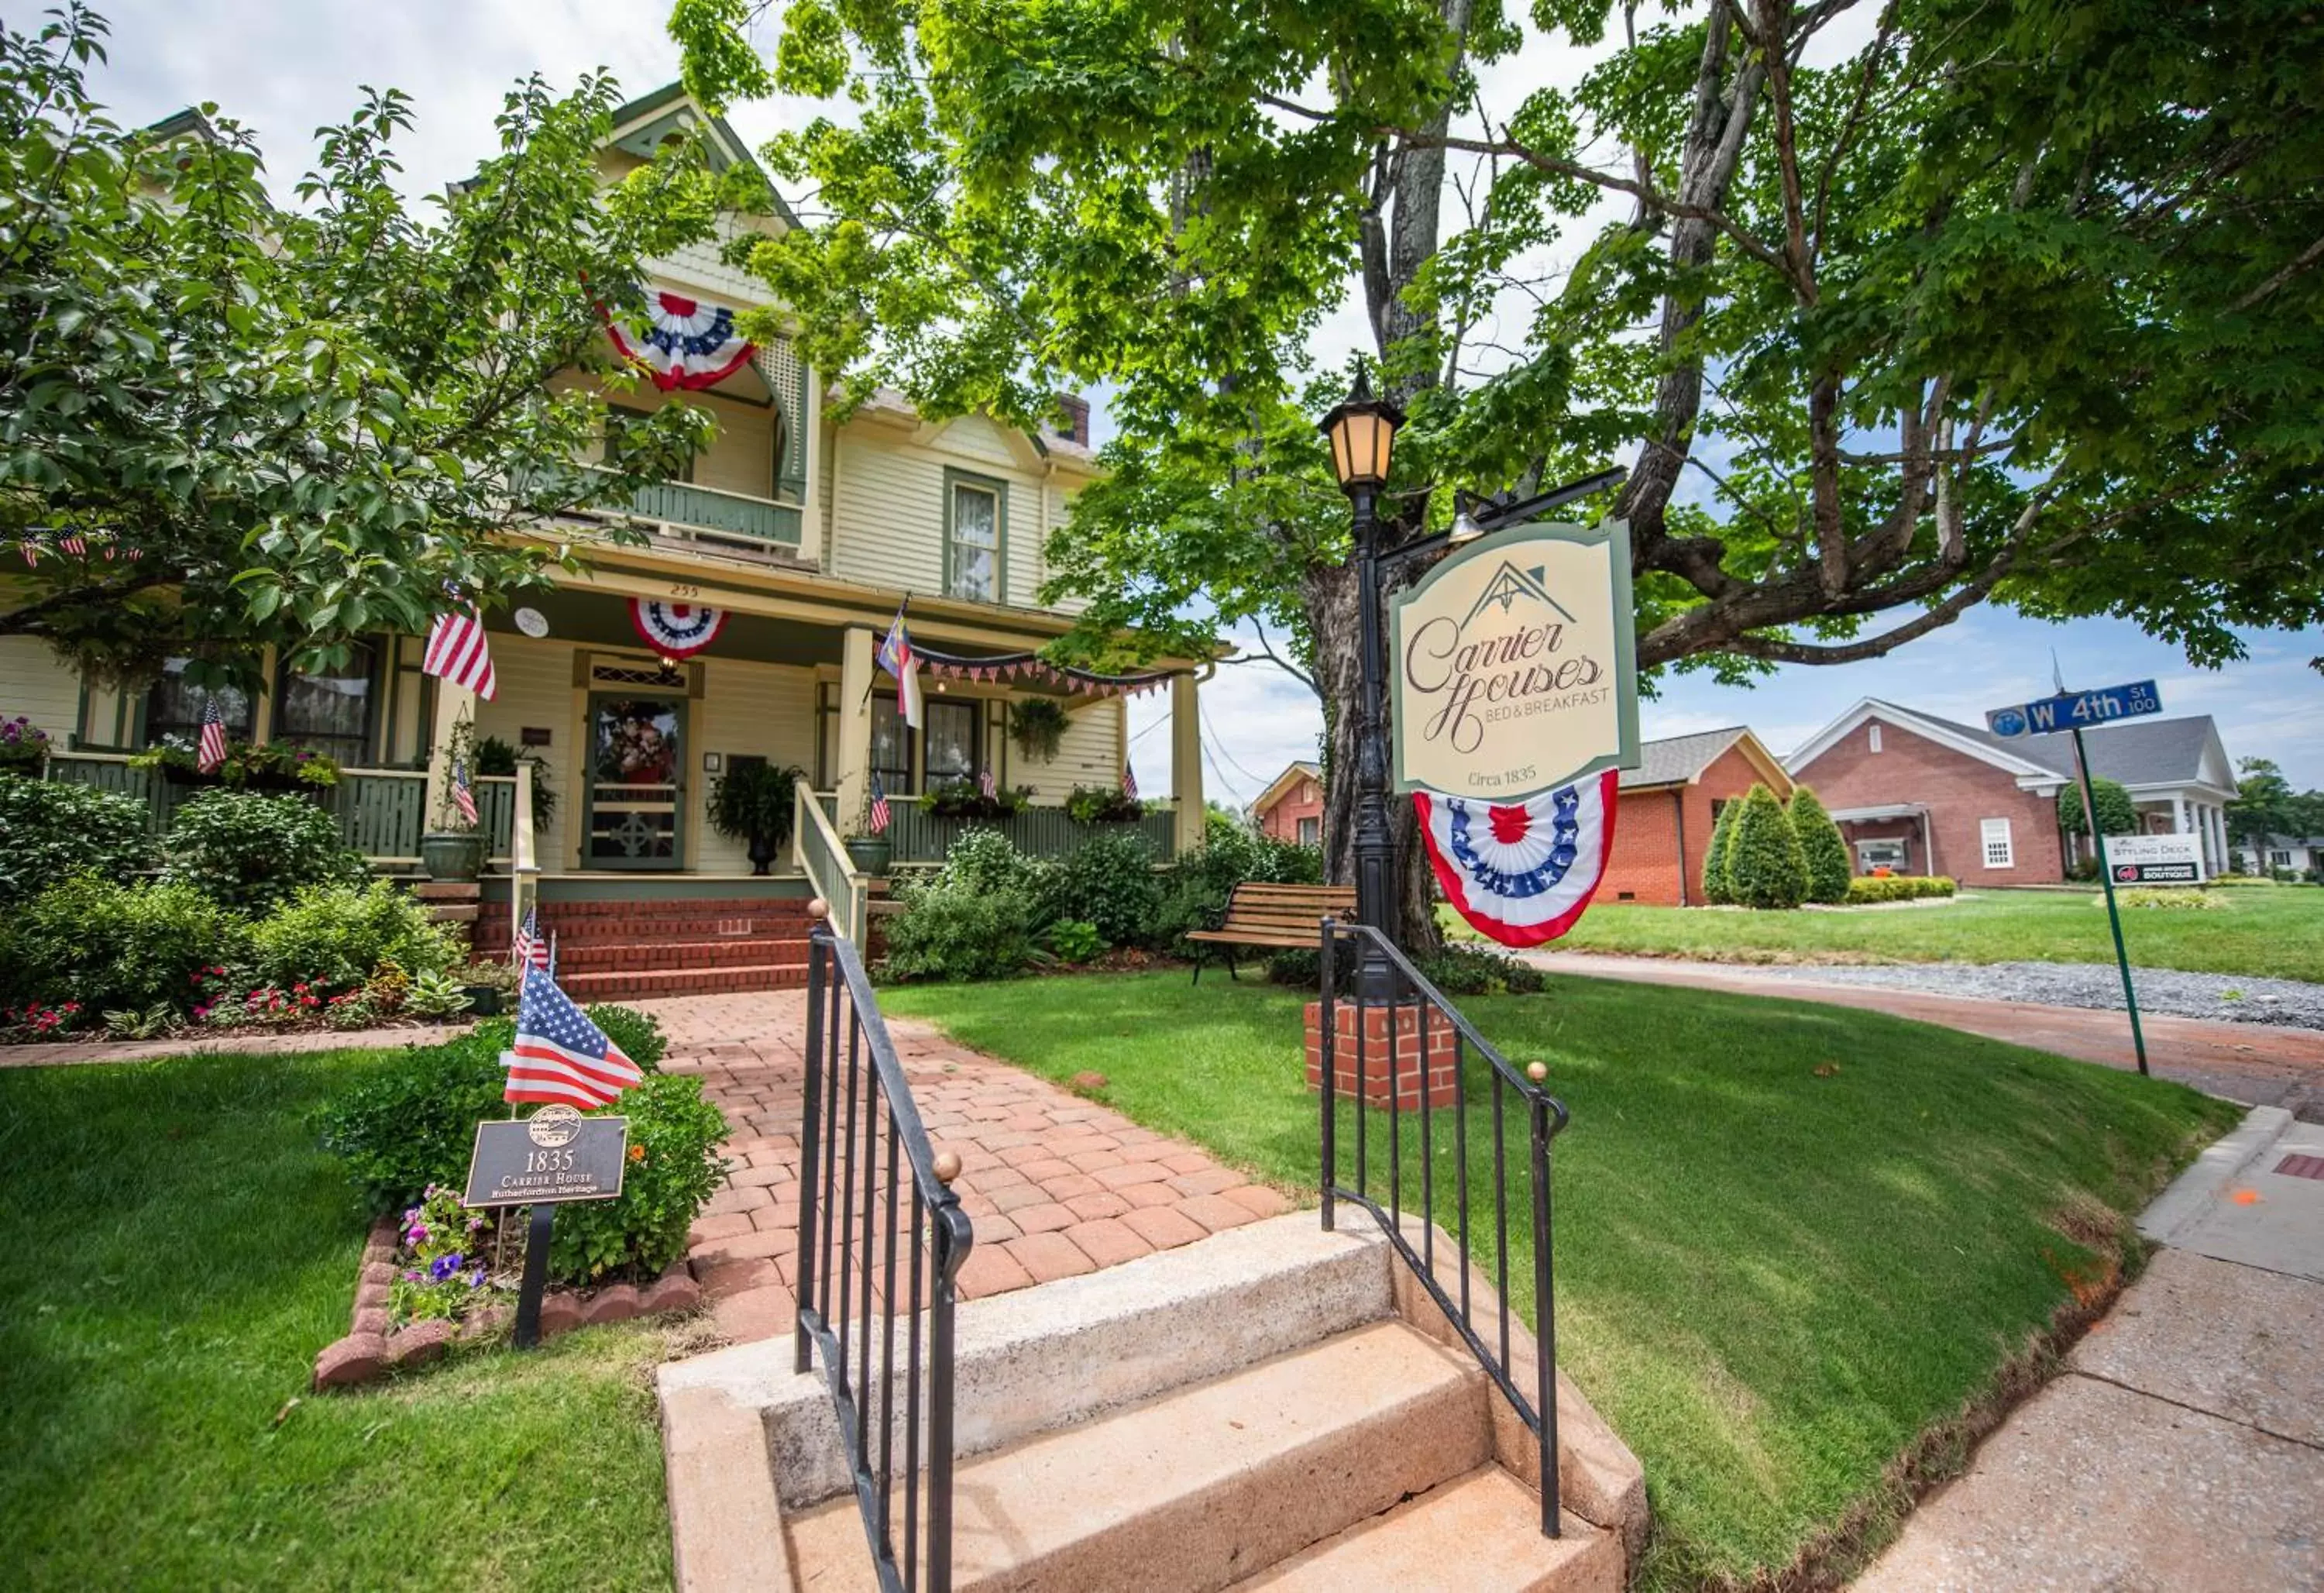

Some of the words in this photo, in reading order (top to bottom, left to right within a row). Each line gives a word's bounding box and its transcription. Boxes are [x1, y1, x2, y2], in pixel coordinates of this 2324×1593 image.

[671, 584, 698, 597] 255
[1406, 616, 1563, 693] Carrier
[2130, 686, 2148, 700] St
[1424, 655, 1604, 754] Houses
[2031, 704, 2054, 729] W
[2071, 693, 2122, 720] 4th
[2129, 697, 2157, 714] 100
[1468, 771, 1501, 787] Circa
[1504, 764, 1537, 785] 1835
[525, 1150, 575, 1172] 1835
